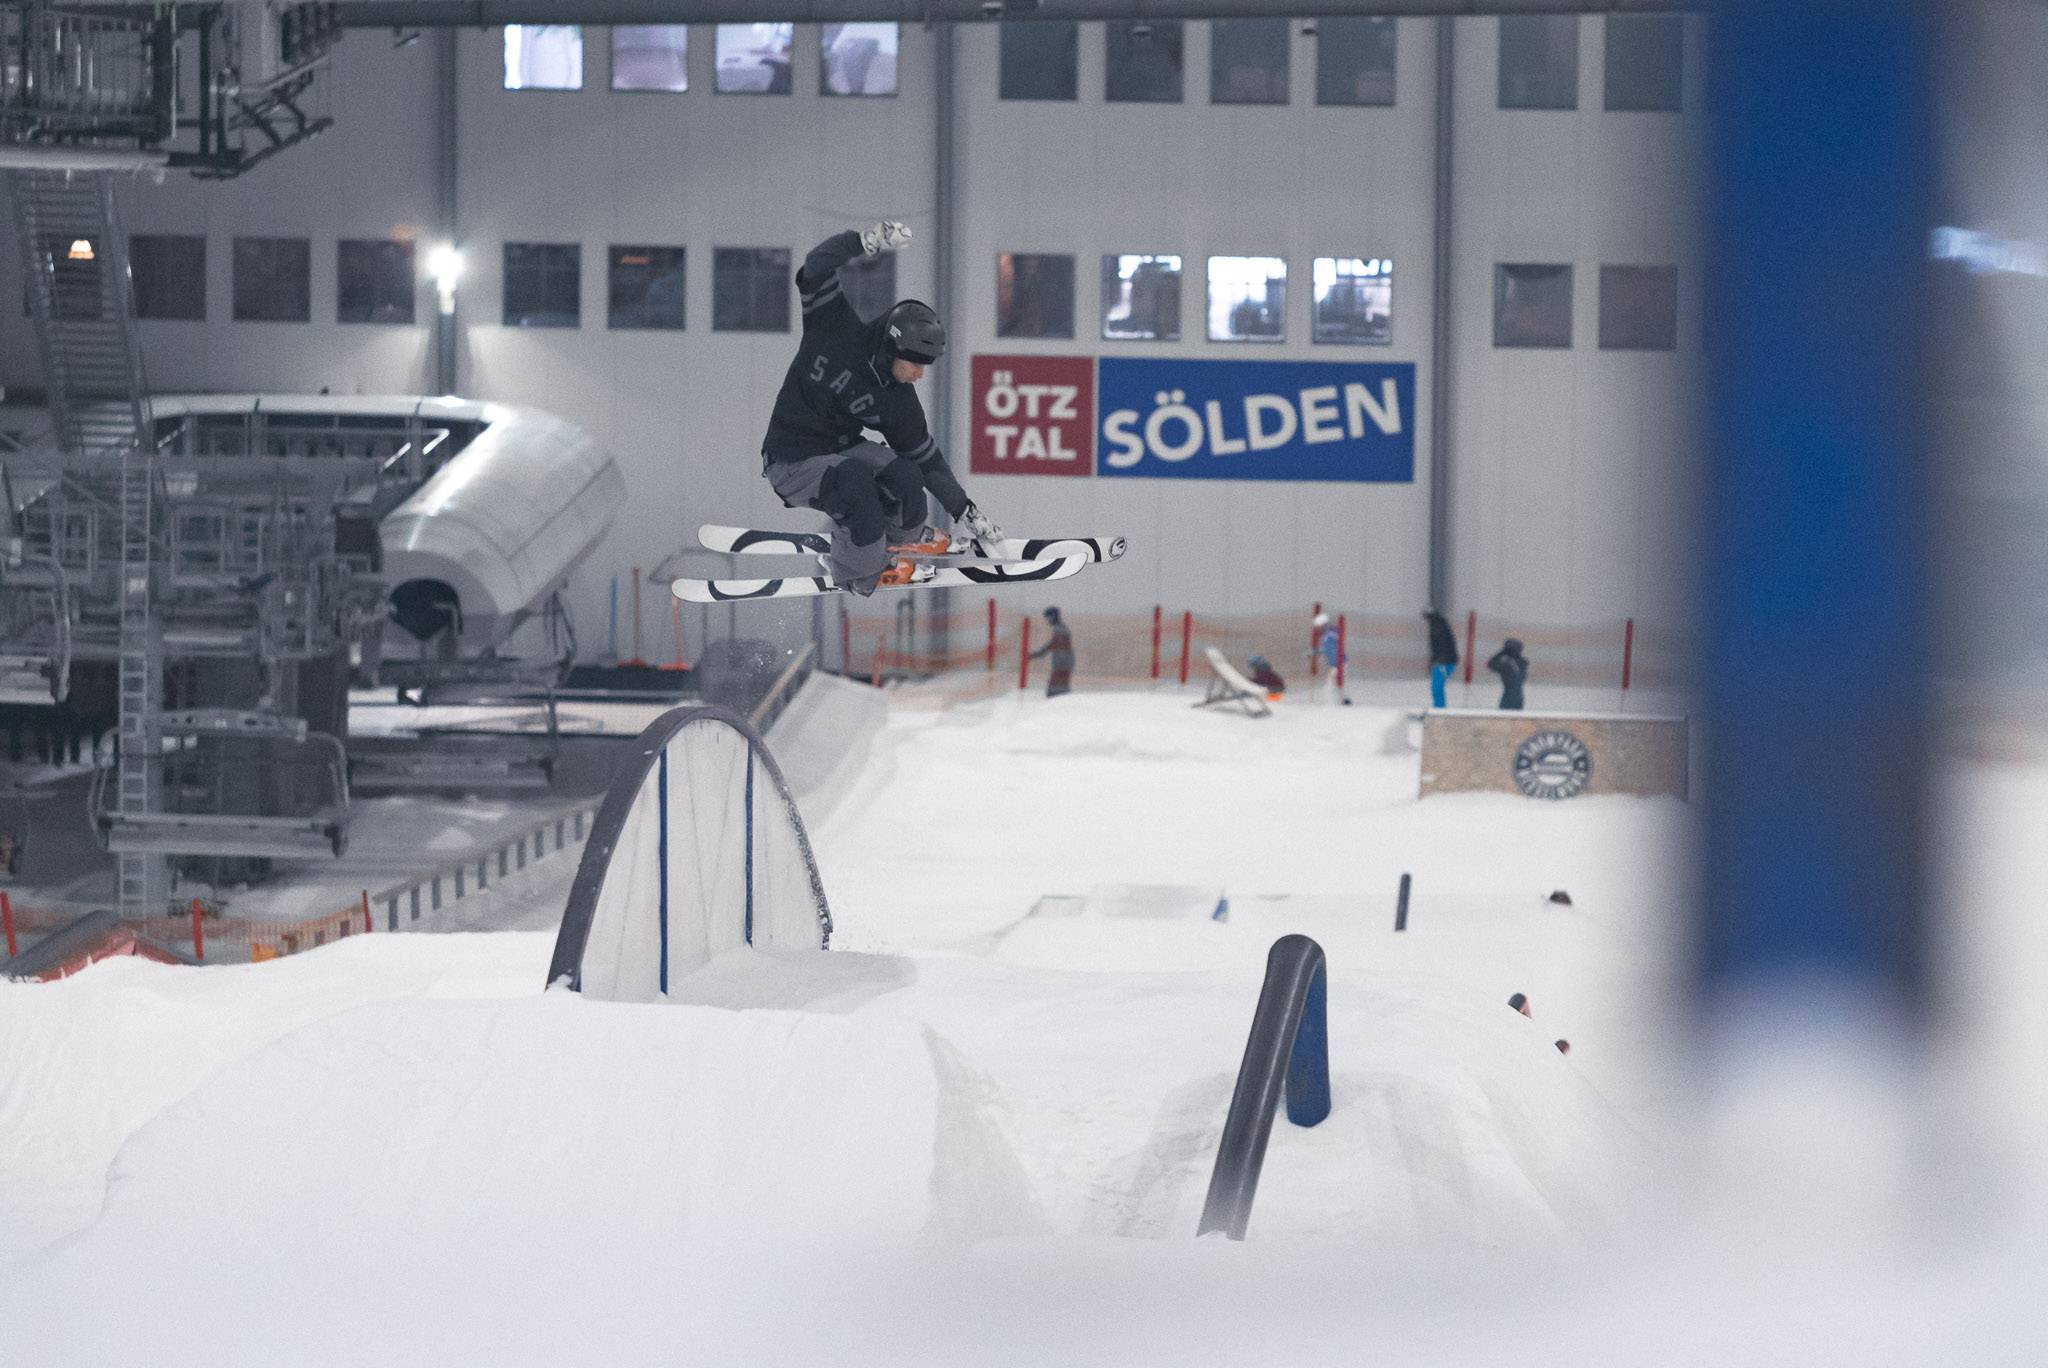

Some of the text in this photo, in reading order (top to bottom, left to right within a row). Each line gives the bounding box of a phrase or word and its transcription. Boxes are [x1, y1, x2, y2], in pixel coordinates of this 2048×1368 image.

[985, 371, 1078, 418] ÖTZ
[985, 426, 1078, 460] TAL
[1103, 378, 1402, 468] SÖLDEN
